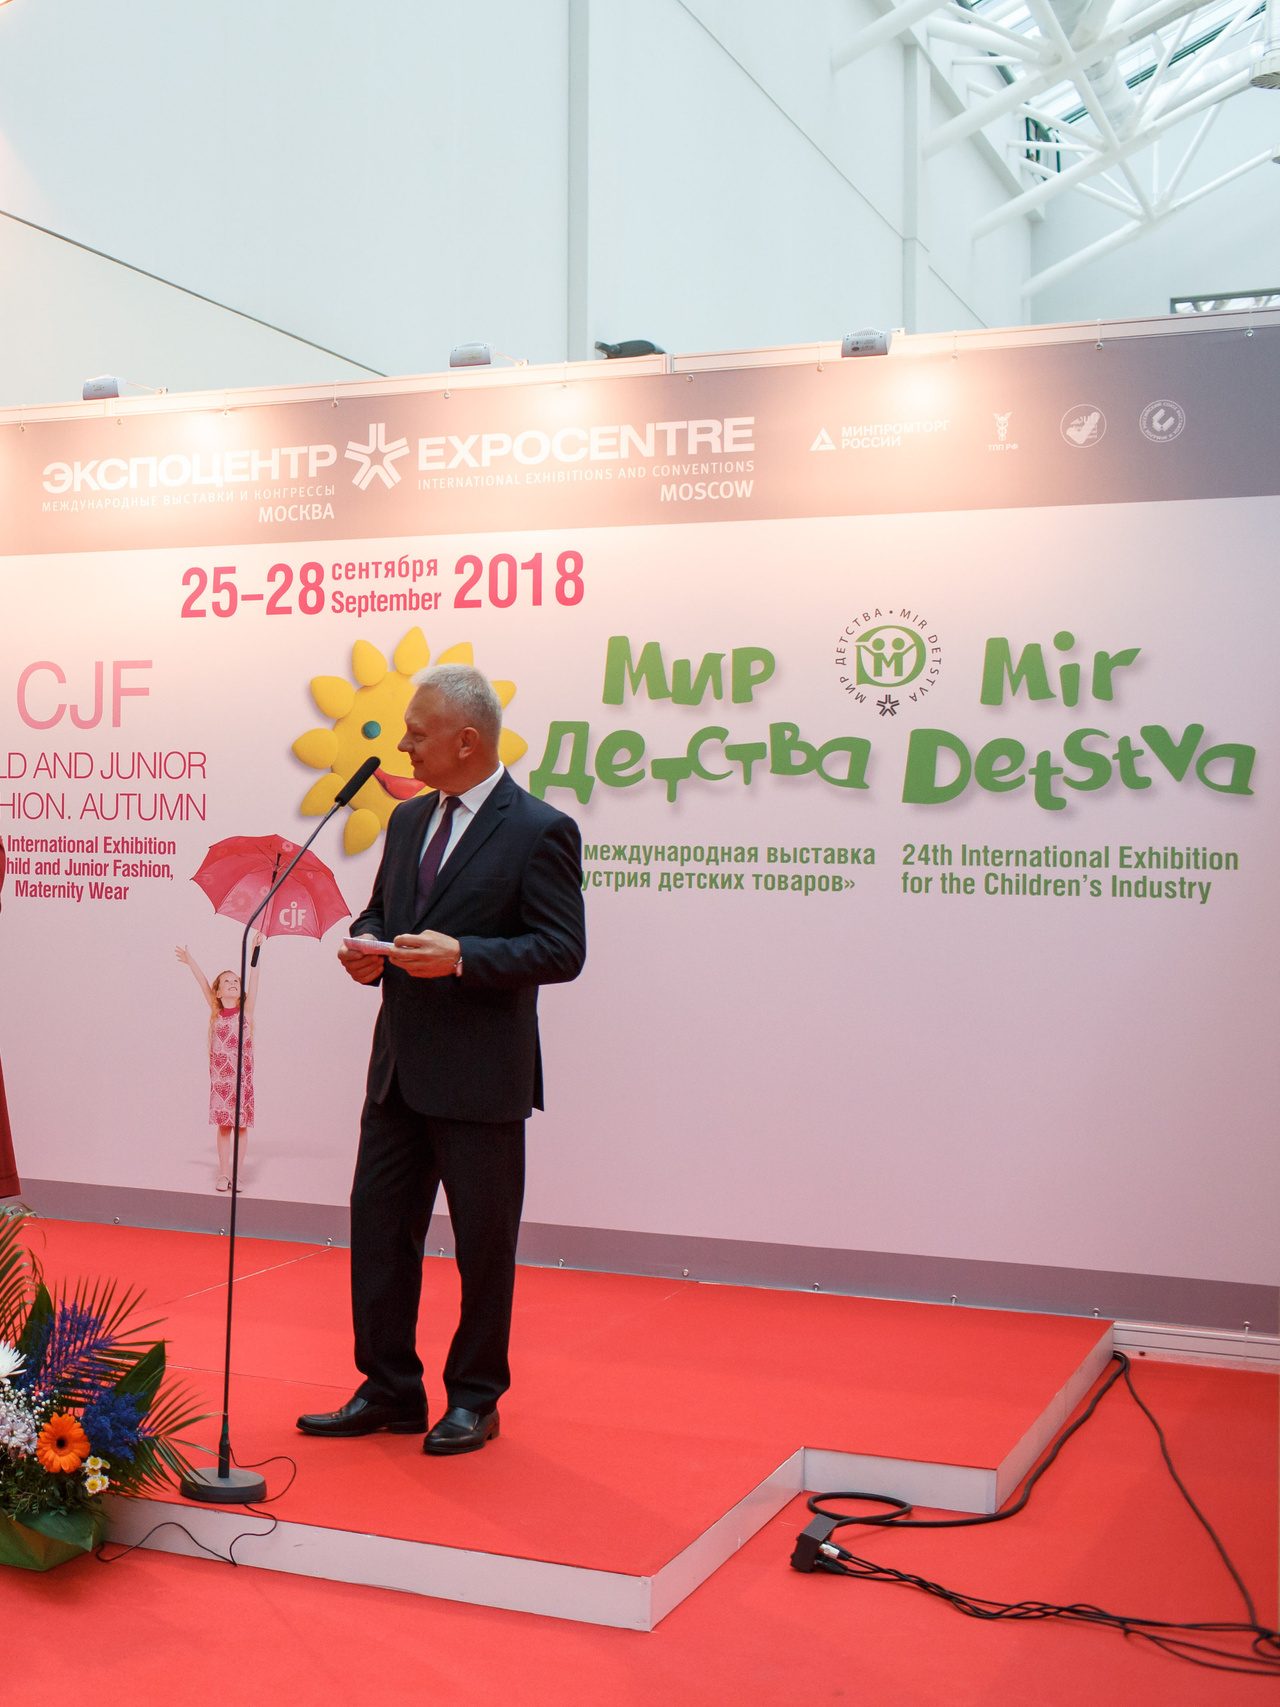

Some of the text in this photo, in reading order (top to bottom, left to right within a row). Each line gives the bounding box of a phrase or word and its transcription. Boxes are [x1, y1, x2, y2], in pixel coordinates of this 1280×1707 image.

[418, 416, 755, 471] EXPOCENTRE
[841, 420, 951, 438] МИНПРОМТОРГ
[841, 435, 901, 449] РОССИИ
[42, 444, 338, 494] ЭКСПОЦЕНТР
[418, 460, 755, 490] INTERNATIONAL EXHIBITIONS AND CONVENTIONS
[42, 484, 335, 512] МЕЖДУНАРОДНЫЕ ВЫСТАВКИ И КОНГРЕССЫ
[660, 479, 755, 502] MOSCOW
[258, 502, 335, 523] МОСКВА
[331, 554, 438, 583] сентября
[453, 549, 585, 609] 2018
[331, 587, 442, 618] September
[835, 608, 882, 704] МИР ДЕТСТВА
[899, 608, 942, 702] MIR DETSTVA
[980, 630, 1142, 707] Mir
[602, 635, 776, 706] Мир
[17, 660, 153, 730] CJF
[33, 752, 94, 779] AND
[100, 751, 207, 780] JUNIOR
[80, 793, 207, 821] AUTUMN
[7, 835, 176, 855] International Exhibition
[583, 844, 876, 866] международная выставка
[902, 843, 1239, 870] 24th International Exhibition
[6, 857, 174, 881] hild and Junior Fashion,
[581, 870, 856, 896] устрия детских товаров»
[15, 880, 130, 902] Maternity Wear
[901, 871, 1212, 904] for the Children’s Industry
